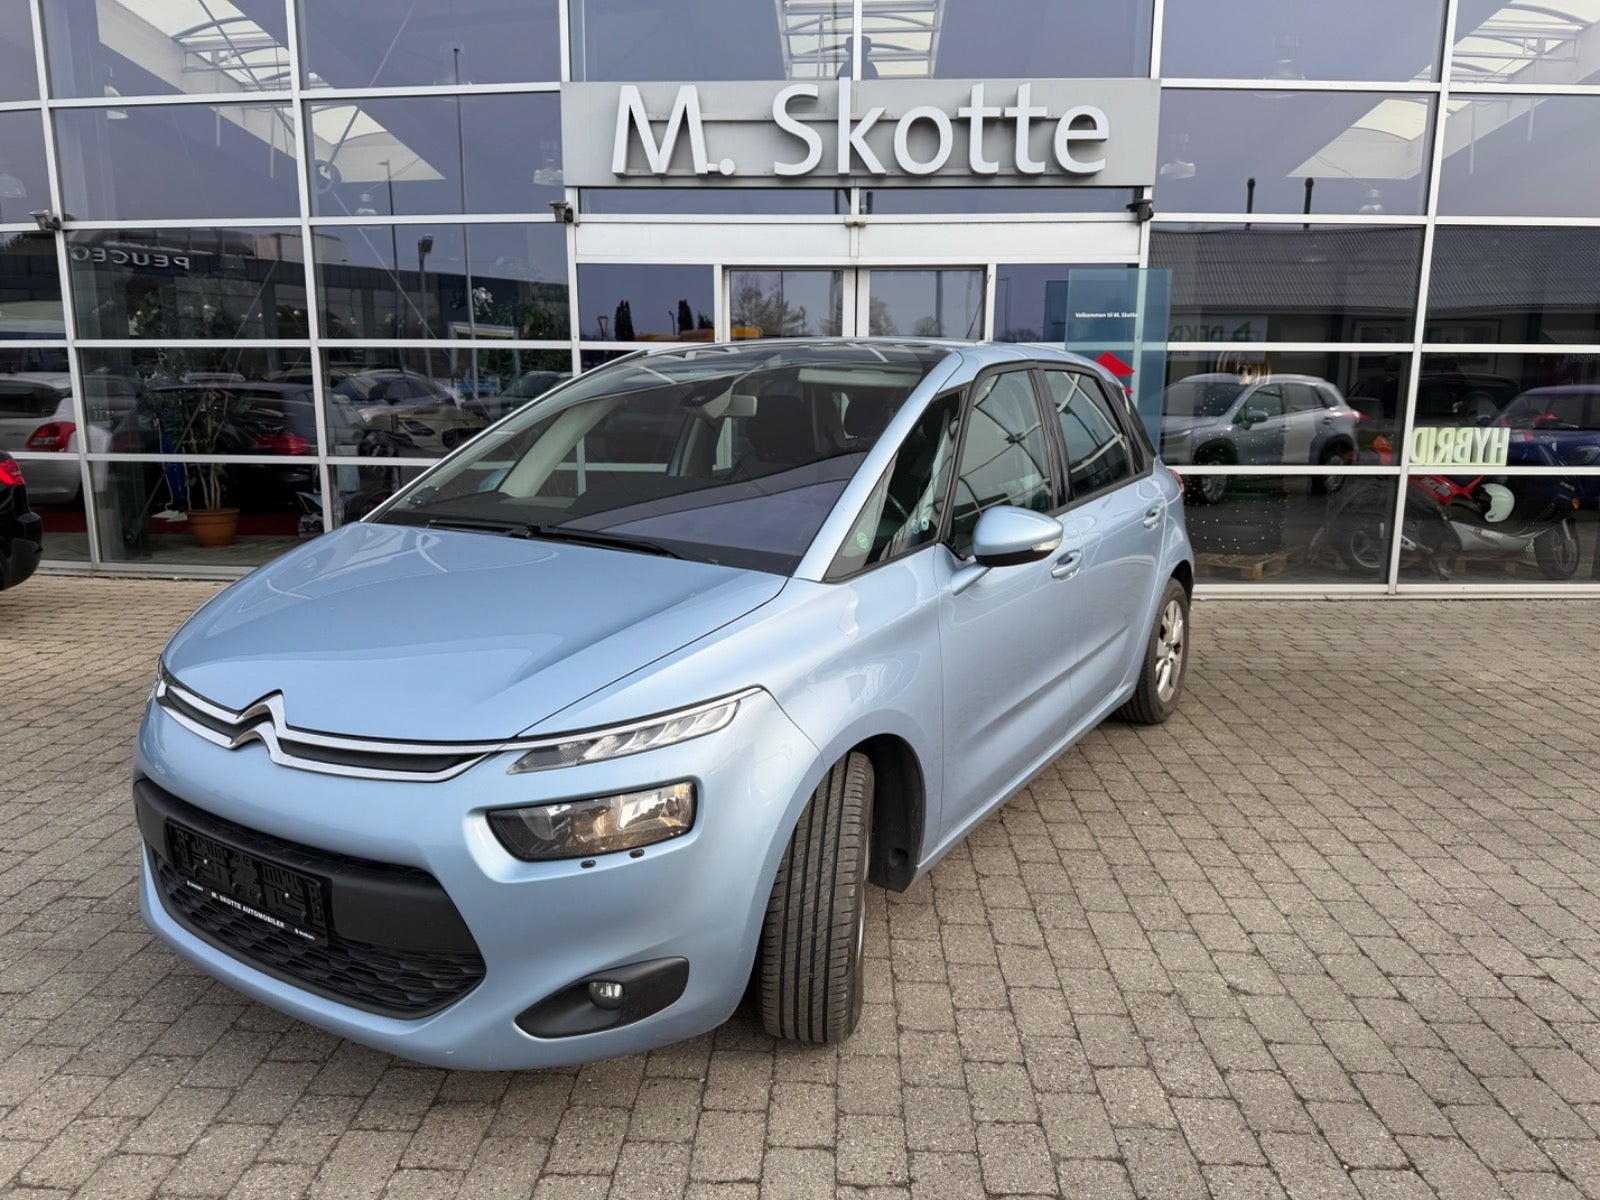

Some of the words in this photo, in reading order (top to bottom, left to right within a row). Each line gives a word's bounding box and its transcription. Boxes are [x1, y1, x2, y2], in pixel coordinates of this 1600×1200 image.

[611, 84, 736, 177] M.
[773, 77, 1110, 177] Skotte
[219, 895, 242, 910] SKOTTE
[242, 905, 286, 928] AUTOMOBILER
